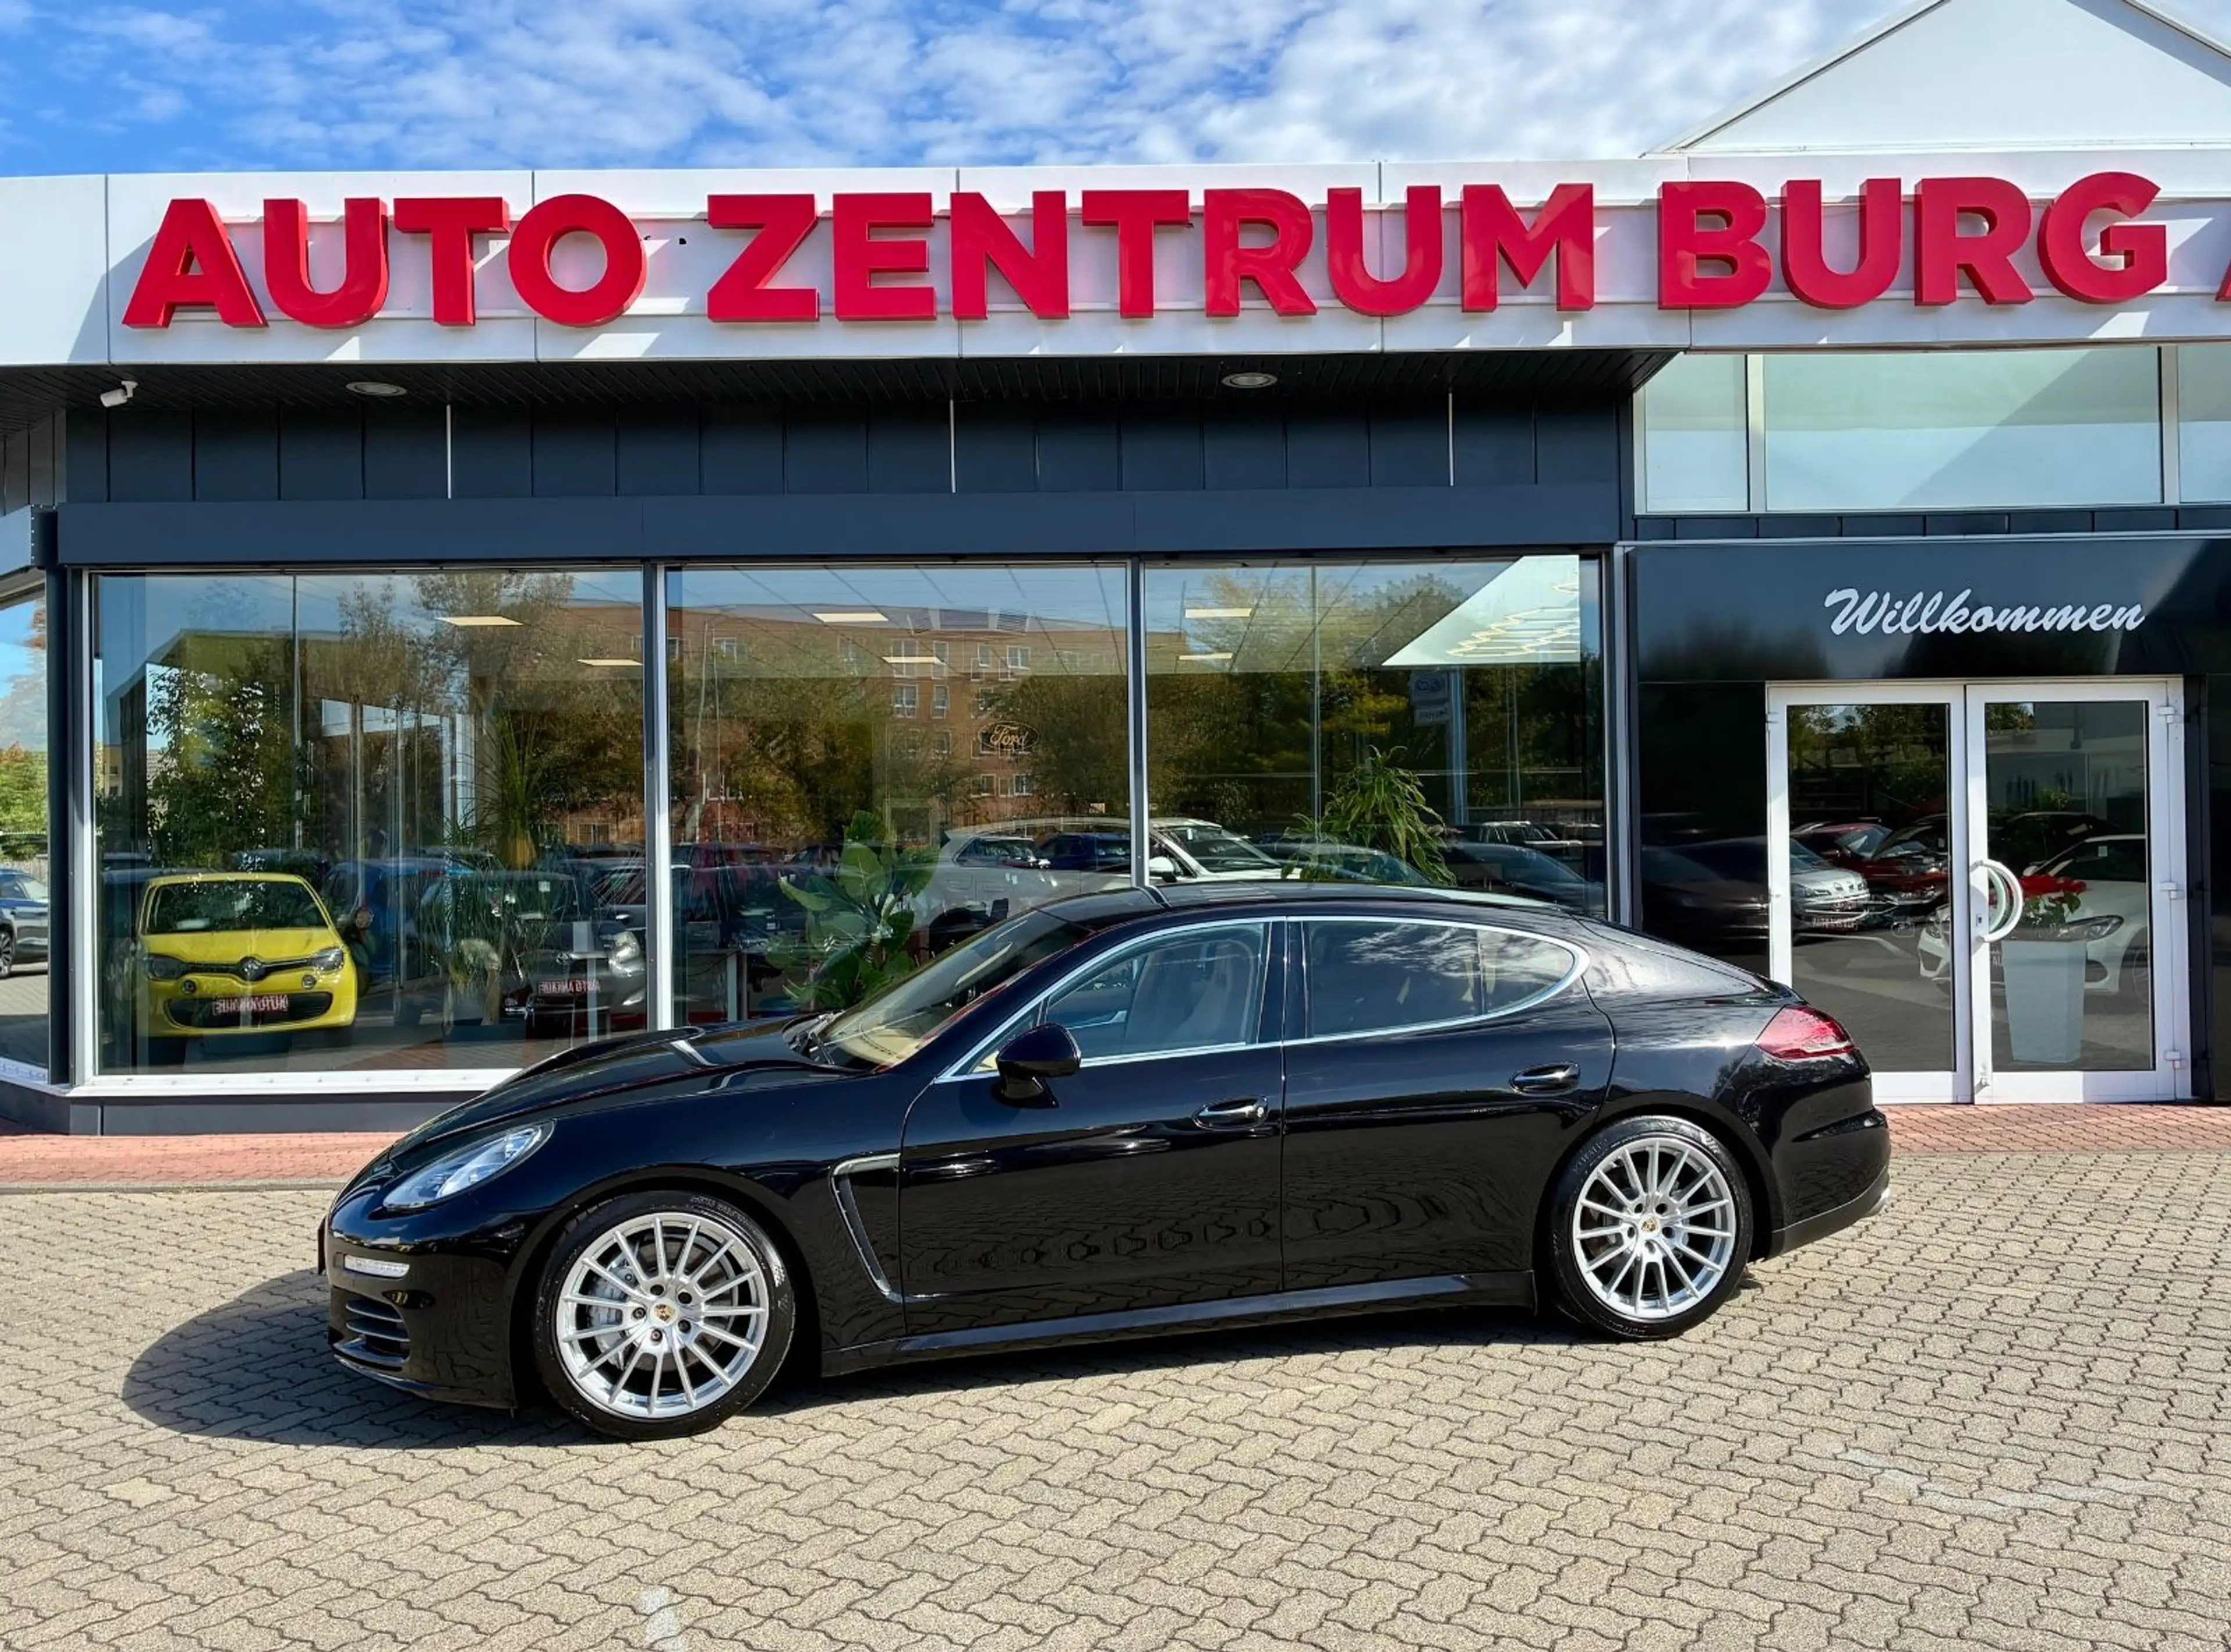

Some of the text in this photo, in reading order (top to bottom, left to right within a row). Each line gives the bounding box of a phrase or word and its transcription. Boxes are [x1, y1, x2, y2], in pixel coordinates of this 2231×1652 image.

[122, 171, 2169, 328] AUTO ZENTRUM BURG
[1824, 588, 2145, 635] Willkommen
[989, 724, 1030, 746] Ford
